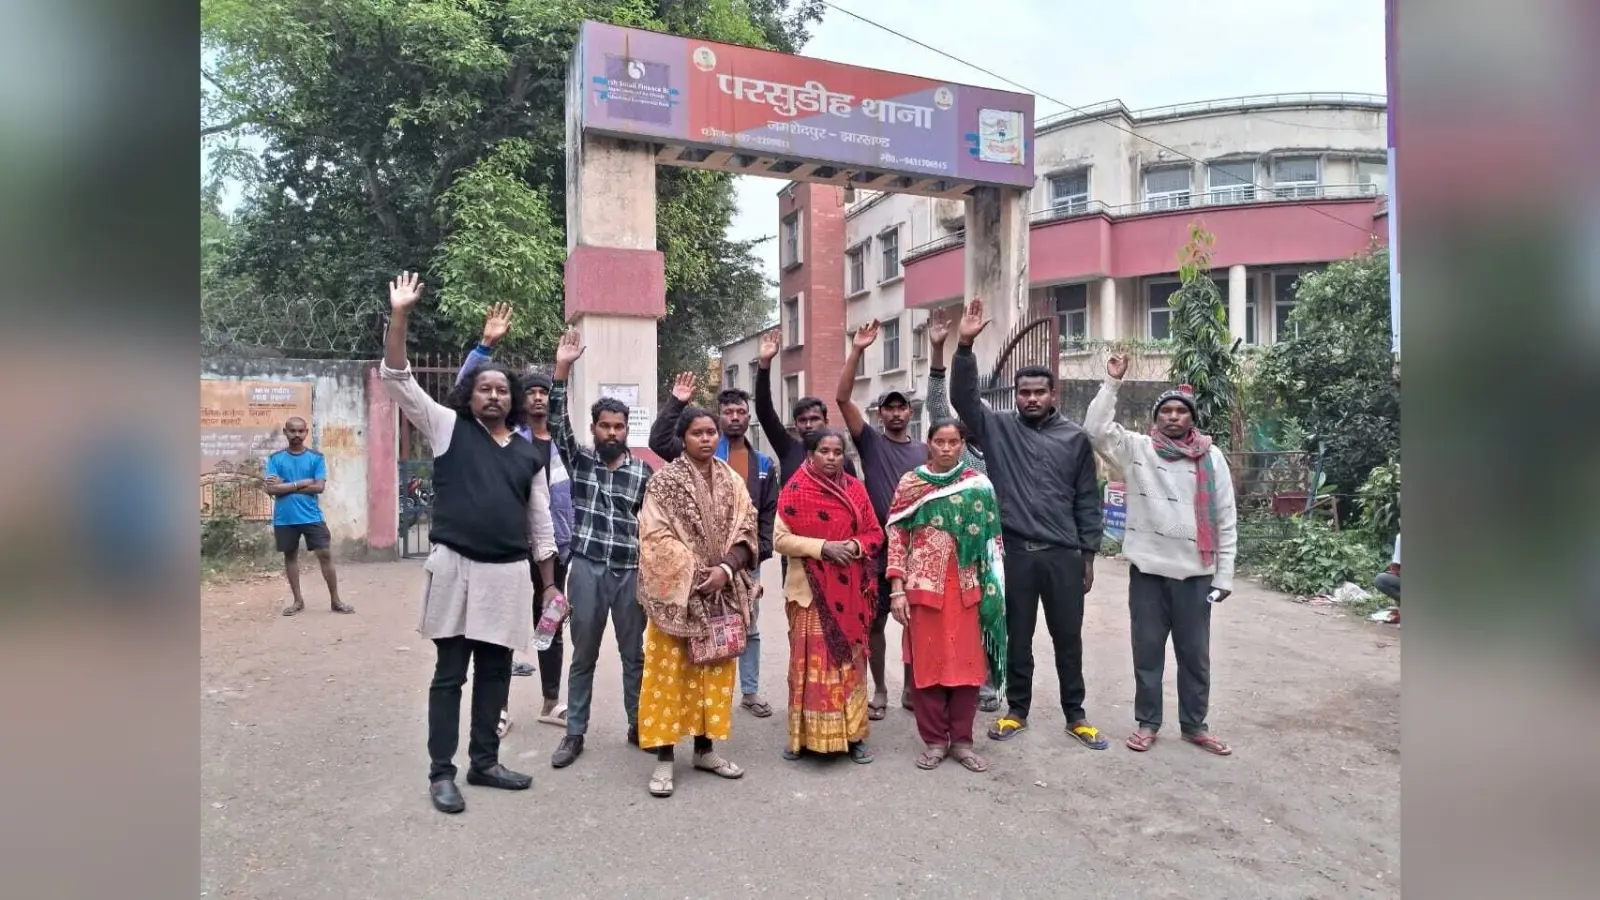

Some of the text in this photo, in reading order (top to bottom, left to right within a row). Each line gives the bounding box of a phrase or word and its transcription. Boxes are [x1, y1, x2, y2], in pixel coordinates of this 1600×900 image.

[638, 83, 661, 93] Finance
[716, 73, 934, 130] परसुडीह थाना
[766, 120, 827, 141] जमशेदपुर
[839, 131, 891, 148] झारखण्ड
